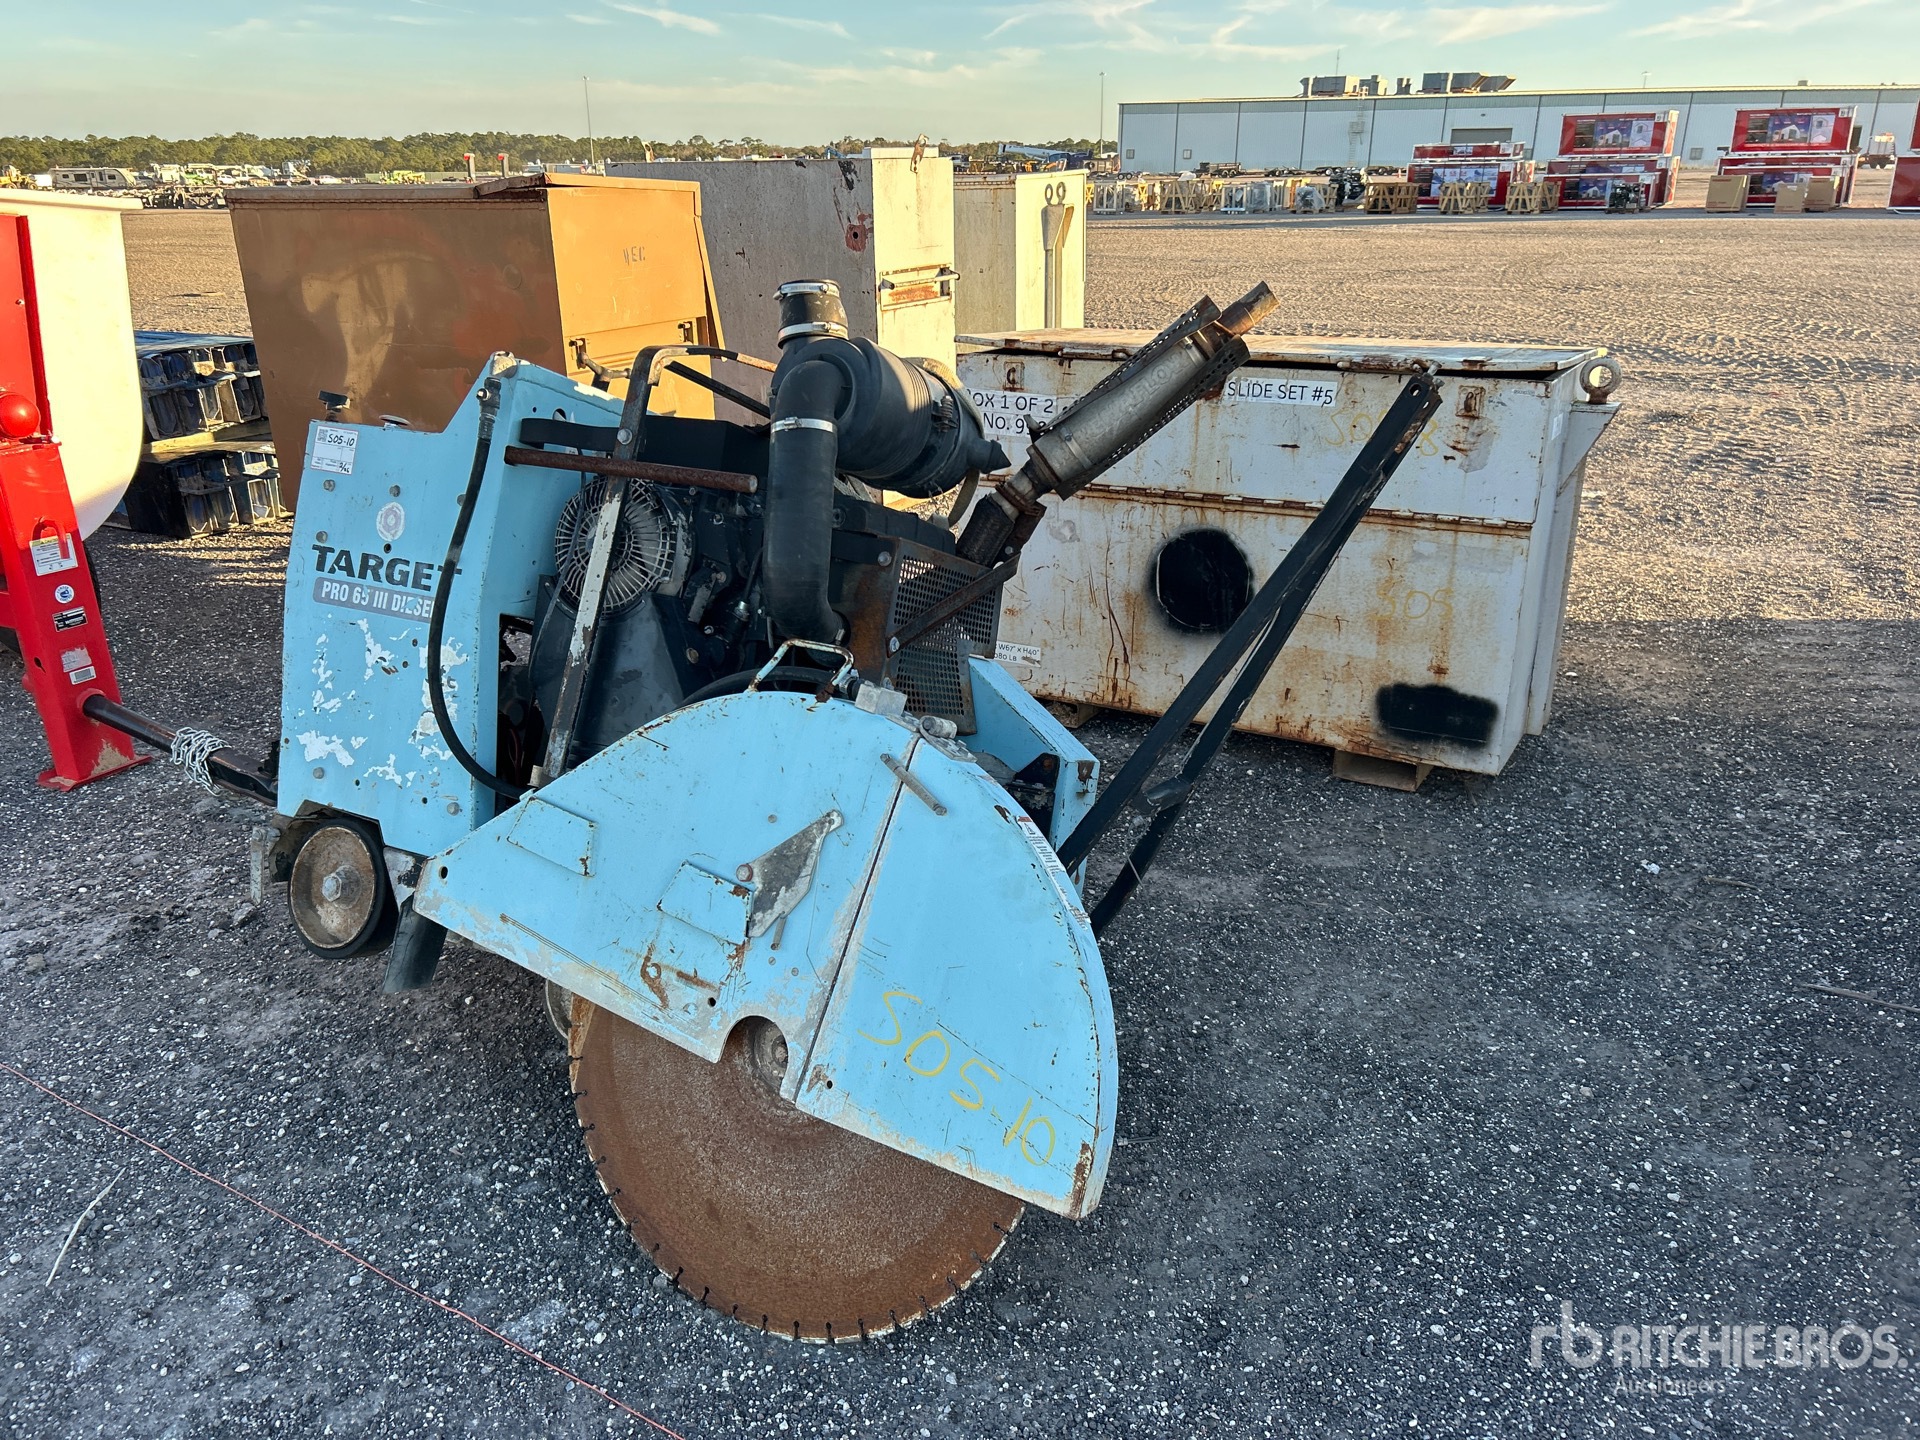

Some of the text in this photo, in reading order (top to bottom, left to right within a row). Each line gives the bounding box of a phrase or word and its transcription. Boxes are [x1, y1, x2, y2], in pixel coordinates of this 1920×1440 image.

[1000, 394, 1010, 410] 1
[1015, 395, 1039, 412] OF
[1043, 398, 1054, 413] 2
[1227, 381, 1334, 408] SLIDE SET #5
[321, 580, 350, 602] PRO
[352, 586, 370, 606] 65
[372, 590, 389, 610] III
